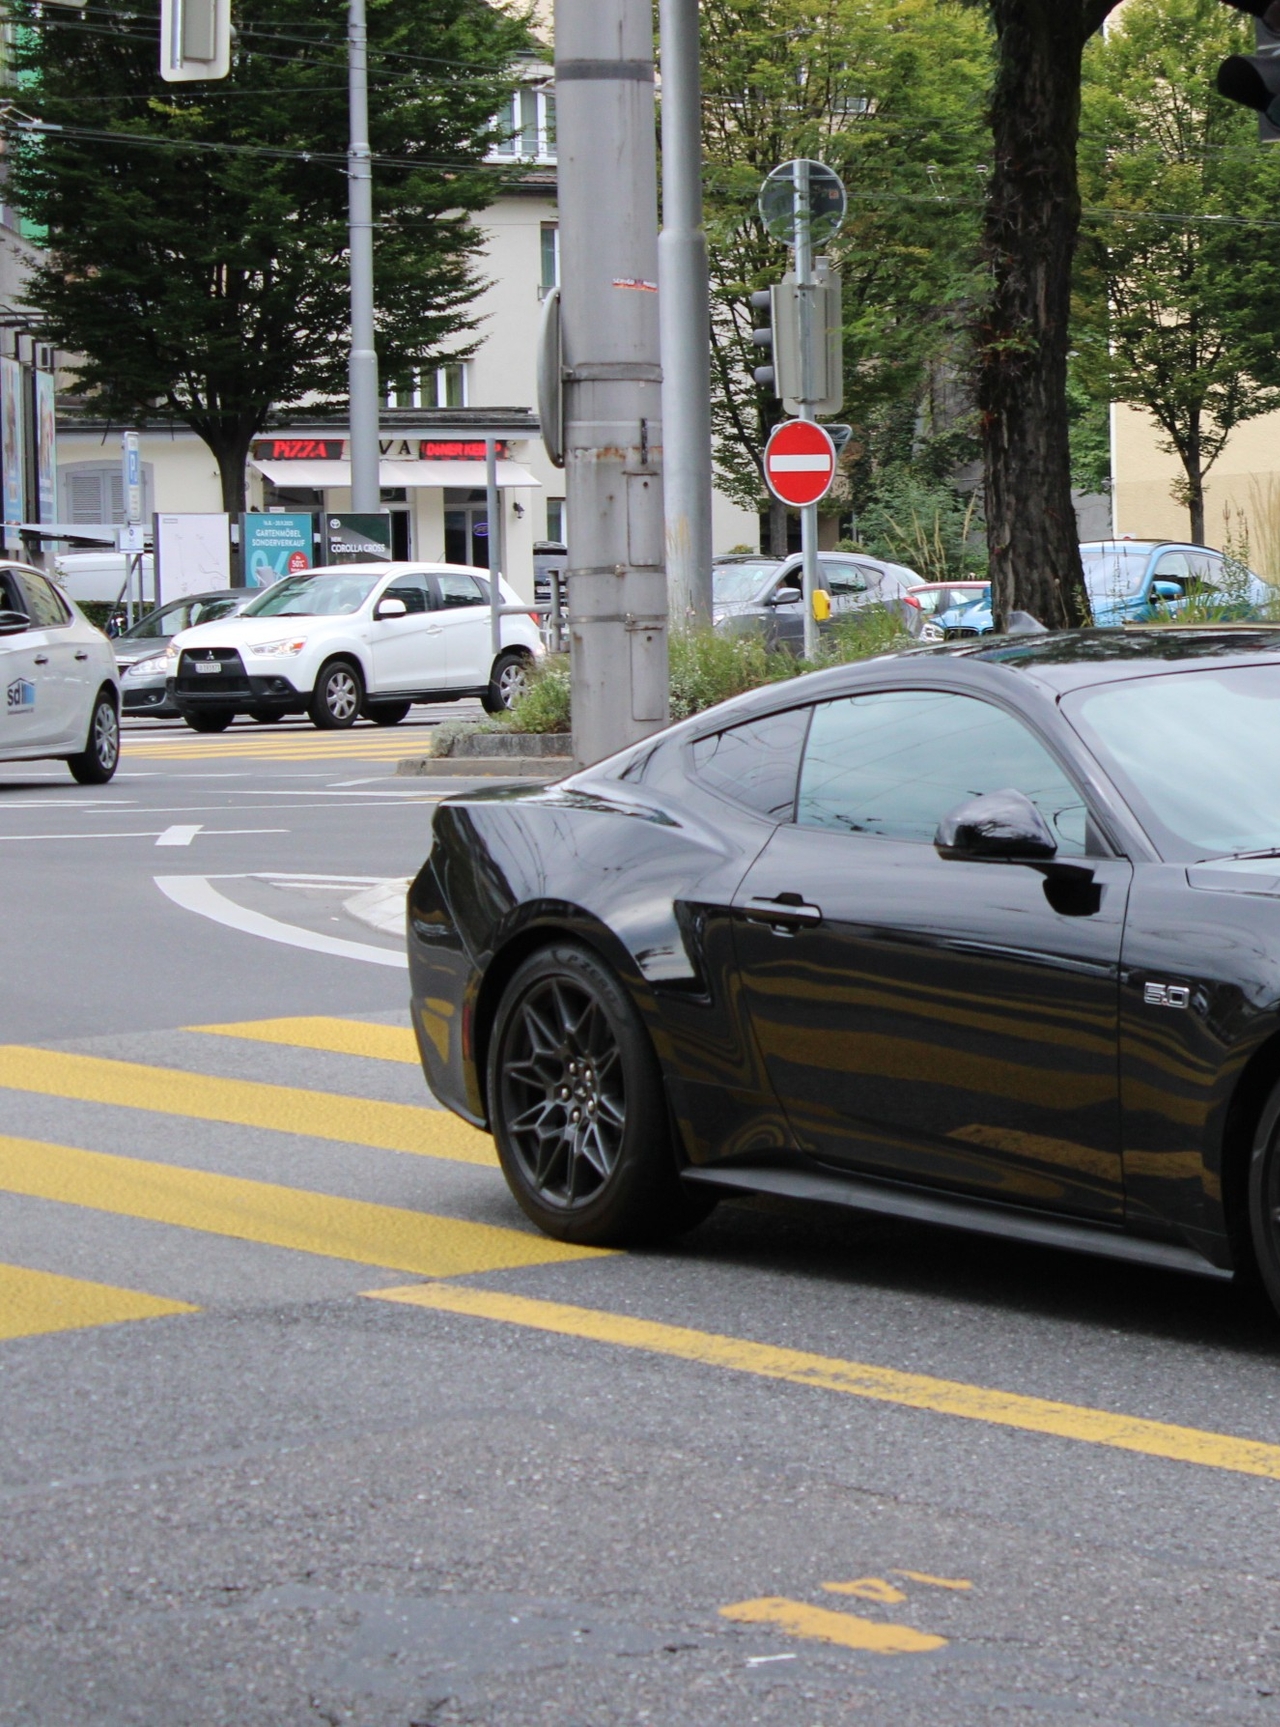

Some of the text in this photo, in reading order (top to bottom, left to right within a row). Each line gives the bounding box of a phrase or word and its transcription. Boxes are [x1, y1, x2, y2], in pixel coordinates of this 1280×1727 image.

[256, 528, 301, 538] GARTENMÖBEL
[252, 538, 305, 547] SONDERVERKAUF
[331, 543, 385, 553] COROLLA CROSS
